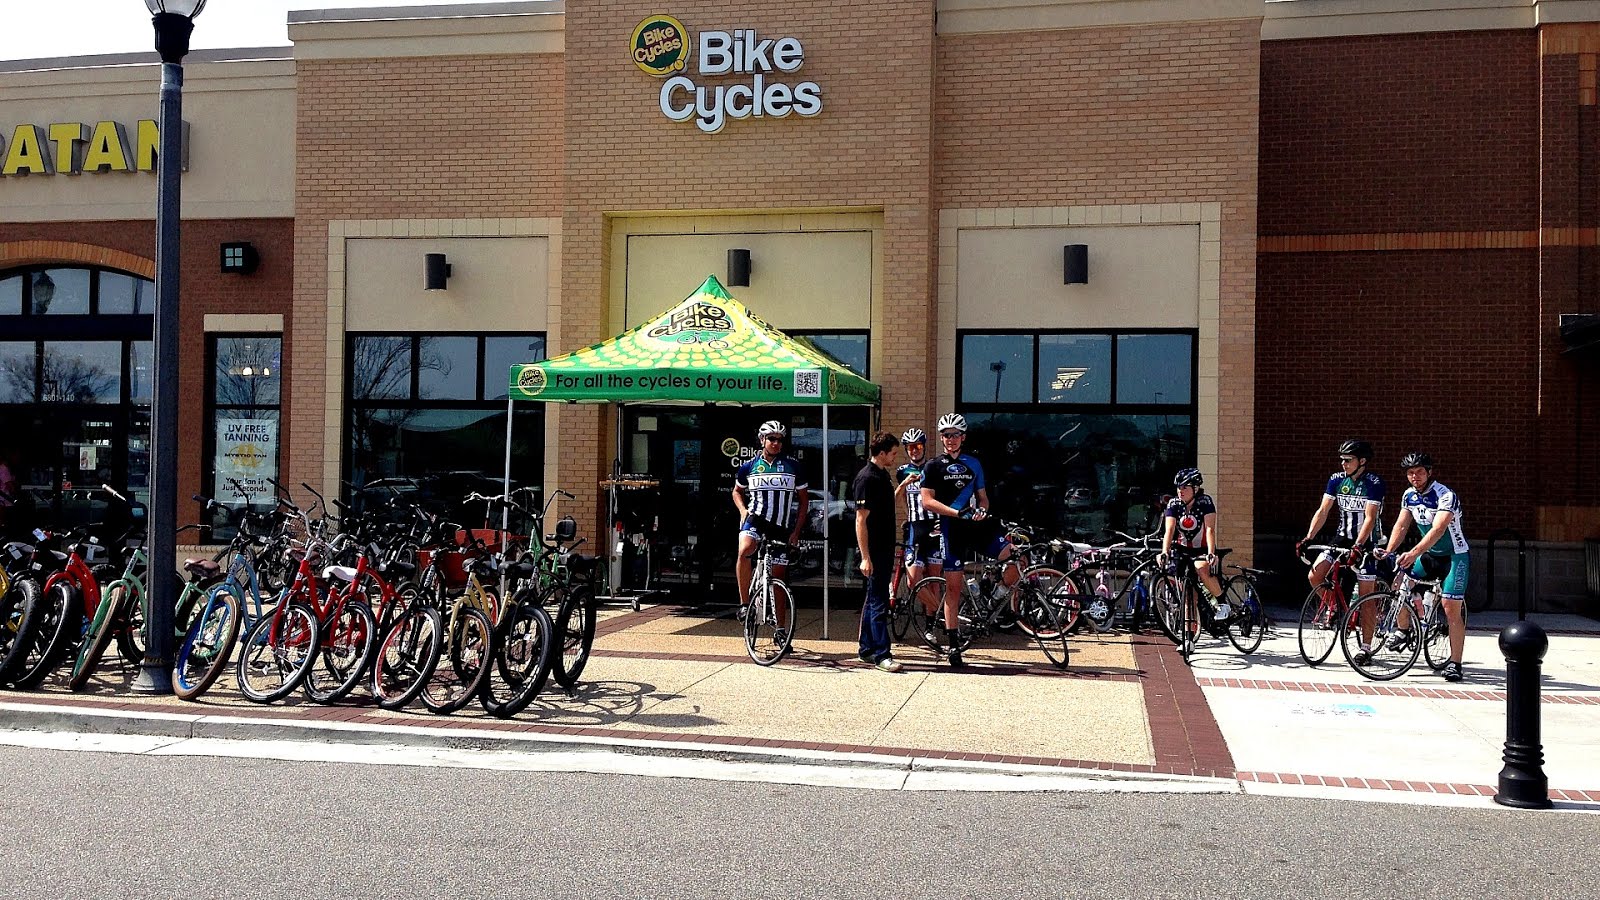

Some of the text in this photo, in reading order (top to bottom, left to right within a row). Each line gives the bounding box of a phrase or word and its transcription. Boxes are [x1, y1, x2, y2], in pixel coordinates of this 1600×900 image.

[643, 26, 675, 45] Bike
[634, 37, 682, 63] Cycles
[699, 29, 804, 74] Bike
[659, 74, 822, 132] Cycles
[670, 302, 725, 325] Bike
[648, 314, 731, 338] Cycles
[556, 373, 788, 392] For all the cycles of your life.
[224, 433, 270, 442] TANNING
[228, 424, 266, 433] UV FREE
[239, 484, 267, 492] econds
[752, 477, 790, 488] UNCW
[232, 491, 256, 499] Awy!
[1339, 498, 1365, 509] UNCW
